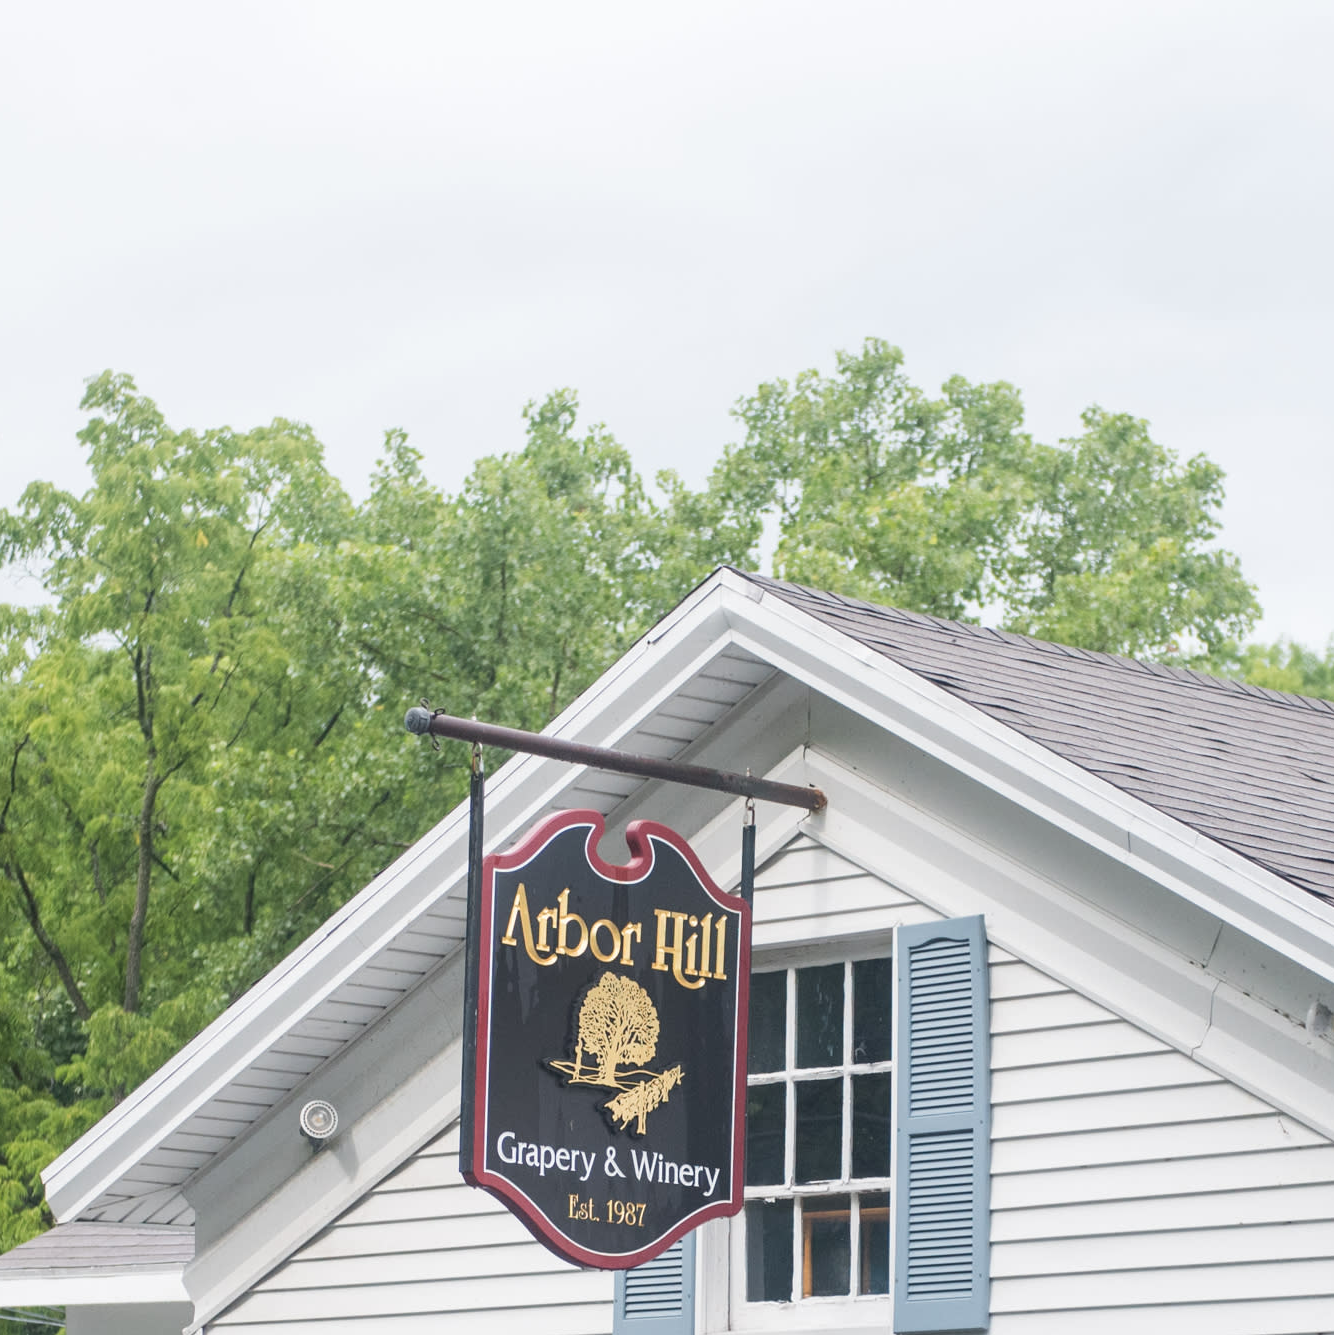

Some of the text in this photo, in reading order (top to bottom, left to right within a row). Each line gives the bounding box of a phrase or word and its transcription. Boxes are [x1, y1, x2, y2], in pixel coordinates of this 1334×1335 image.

[501, 883, 728, 989] Arbor Hill
[497, 1131, 720, 1197] Grapery & Winery
[568, 1194, 647, 1228] Est. 1987
